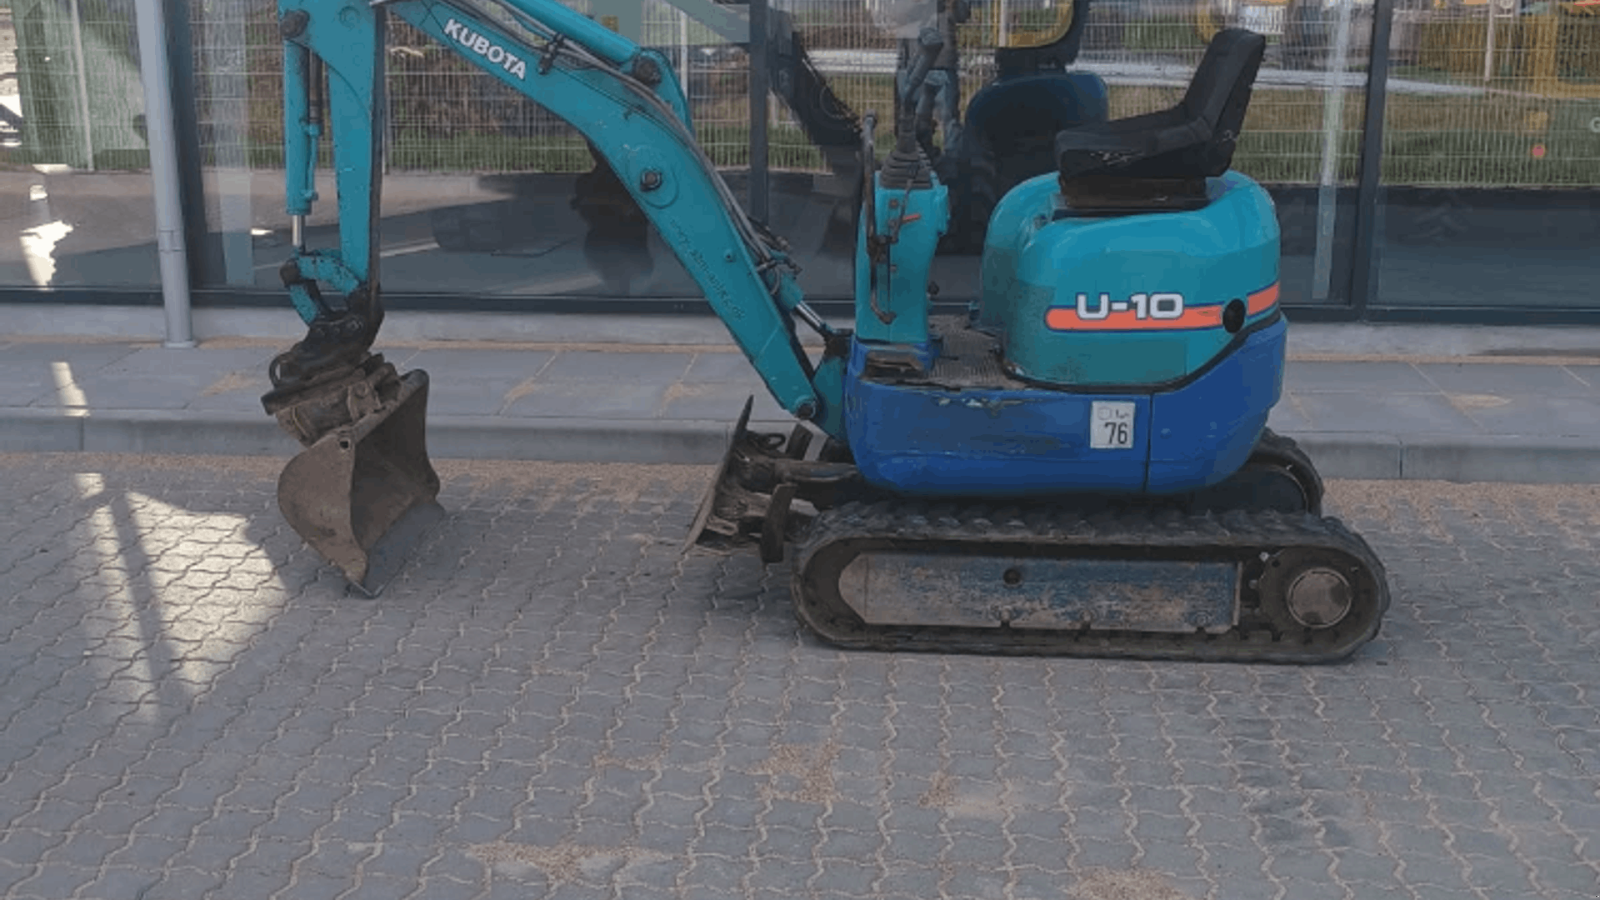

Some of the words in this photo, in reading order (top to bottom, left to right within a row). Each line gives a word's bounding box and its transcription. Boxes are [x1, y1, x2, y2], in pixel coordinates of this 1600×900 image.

[444, 18, 526, 80] KUBOTA
[1076, 293, 1184, 320] U-10
[1105, 422, 1128, 445] 76
